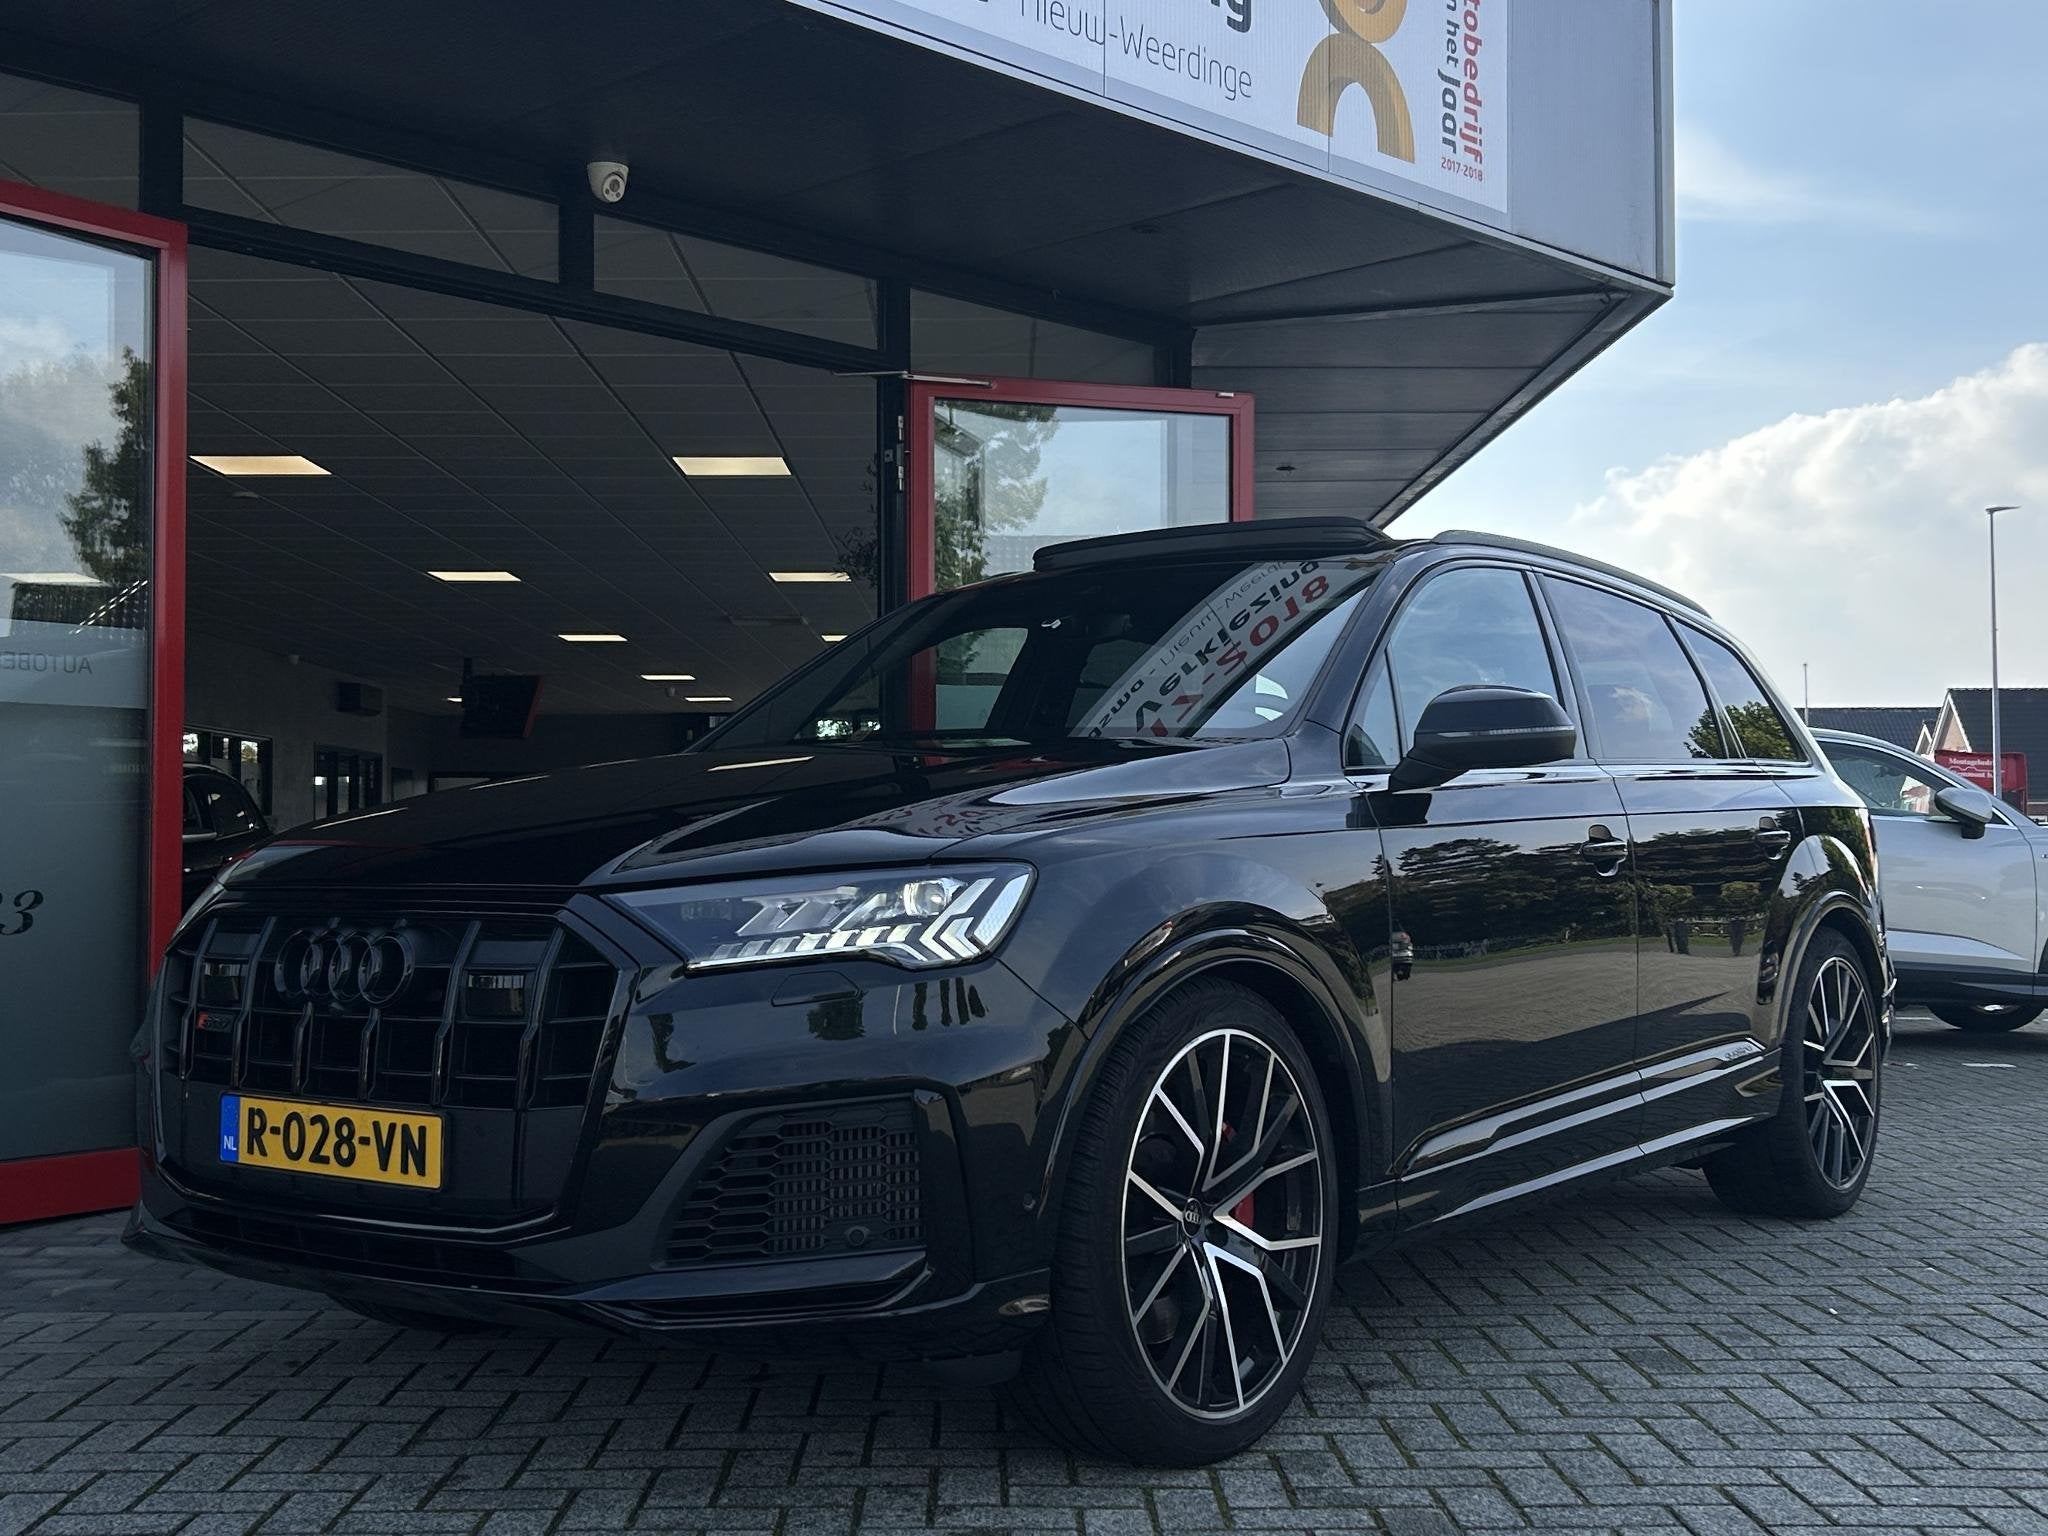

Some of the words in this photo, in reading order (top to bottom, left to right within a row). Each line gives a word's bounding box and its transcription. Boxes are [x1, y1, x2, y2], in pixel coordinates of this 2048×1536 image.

[1446, 19, 1460, 68] het
[1441, 156, 1483, 182] 2017-2018
[0, 889, 44, 936] 3
[223, 1135, 237, 1151] NL
[247, 1106, 427, 1177] R-028-VN
